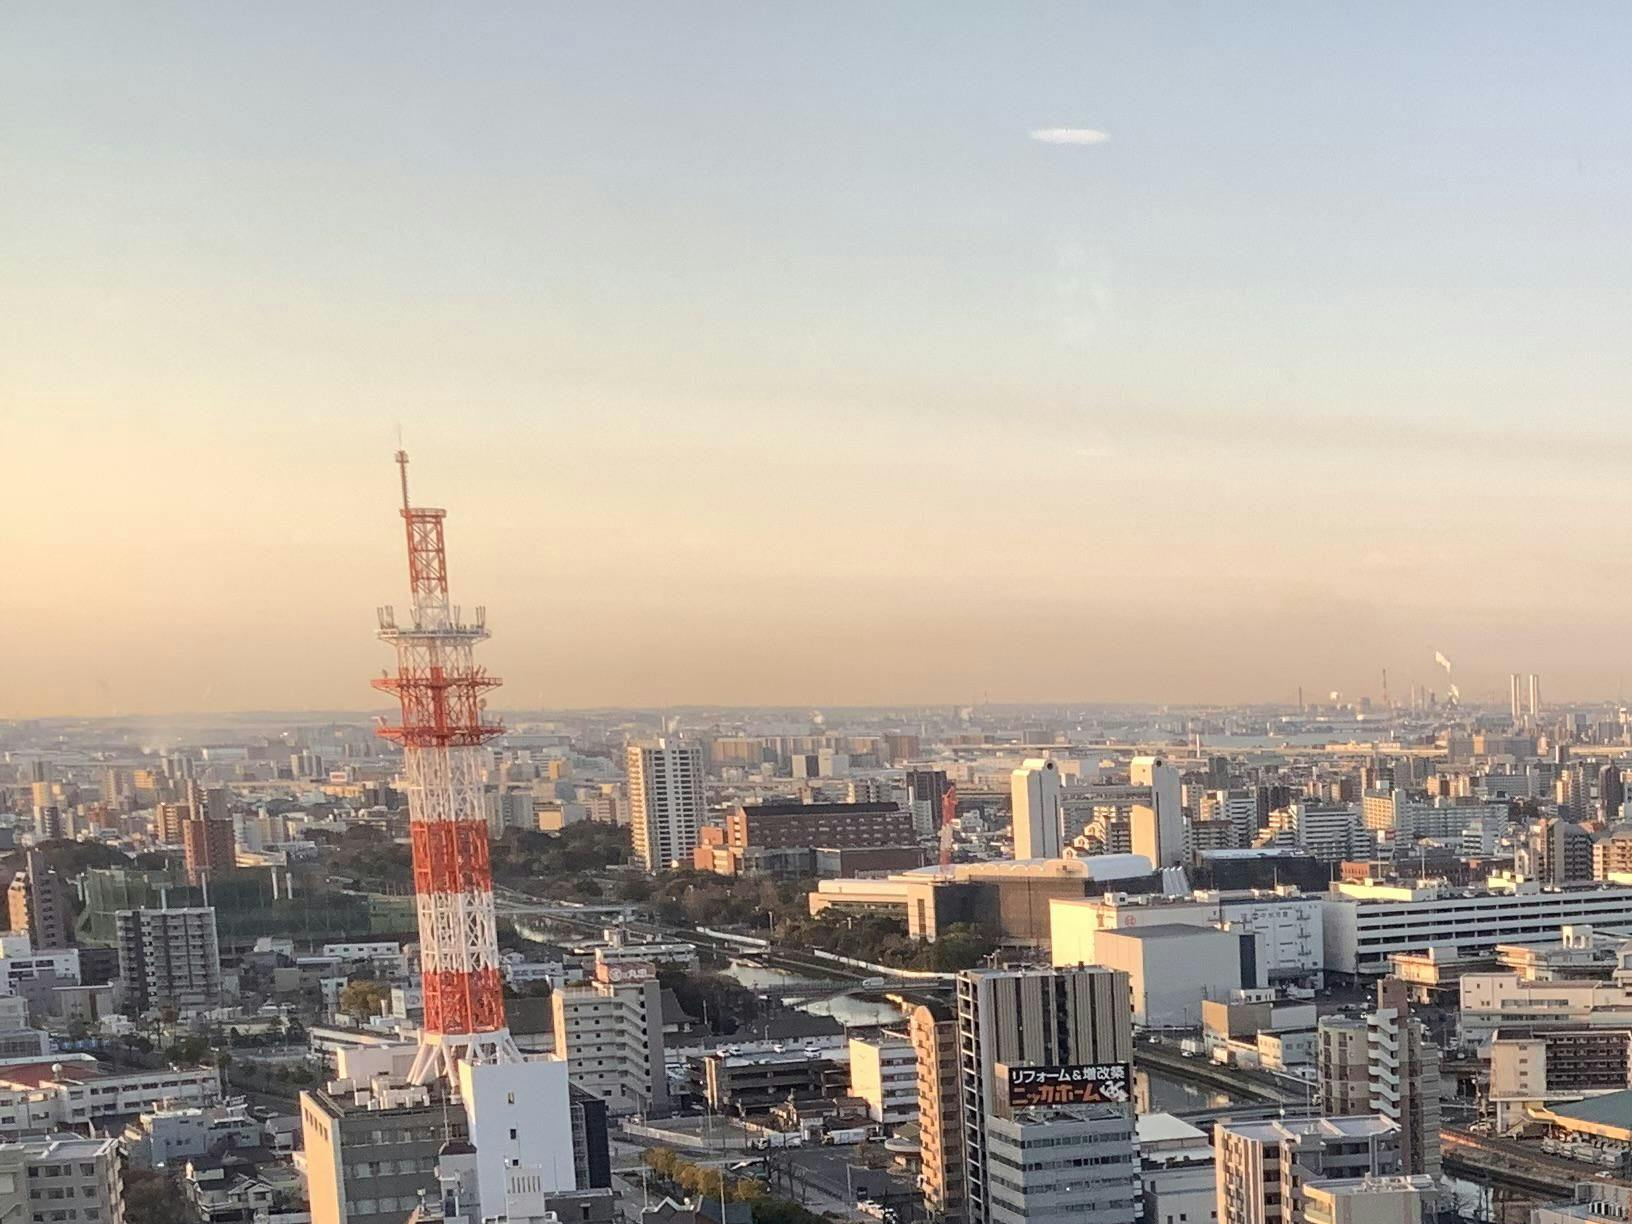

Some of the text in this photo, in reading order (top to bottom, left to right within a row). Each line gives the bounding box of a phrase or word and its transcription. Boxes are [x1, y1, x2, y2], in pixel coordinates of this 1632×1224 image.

[1012, 1083, 1101, 1105] ニッカホーム
